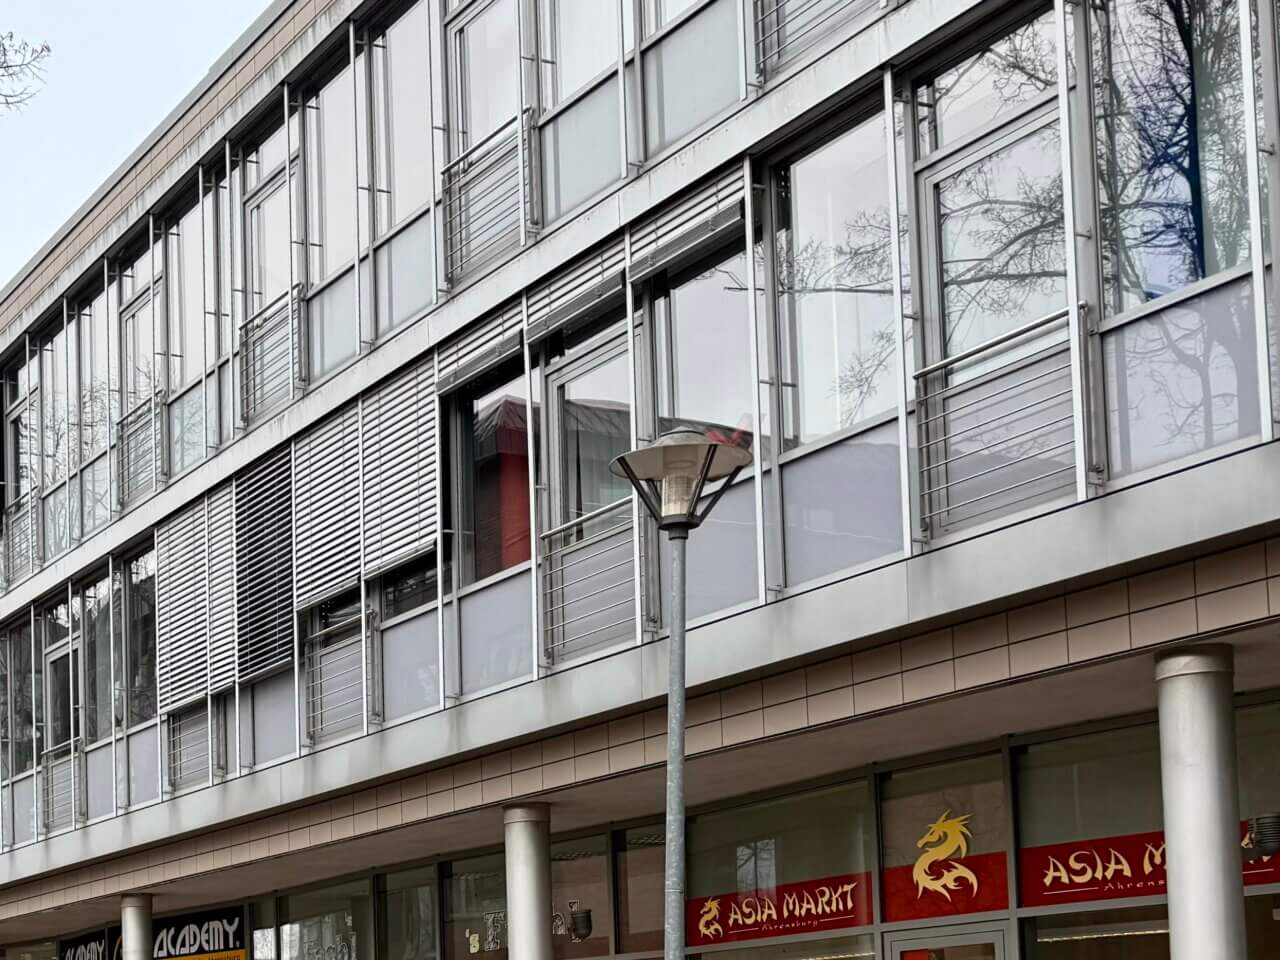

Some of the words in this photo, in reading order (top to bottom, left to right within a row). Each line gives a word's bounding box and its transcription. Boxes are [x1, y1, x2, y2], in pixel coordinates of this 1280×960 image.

[1043, 848, 1132, 887] ASIA
[728, 896, 777, 927] ASIA
[783, 881, 858, 918] MARKT
